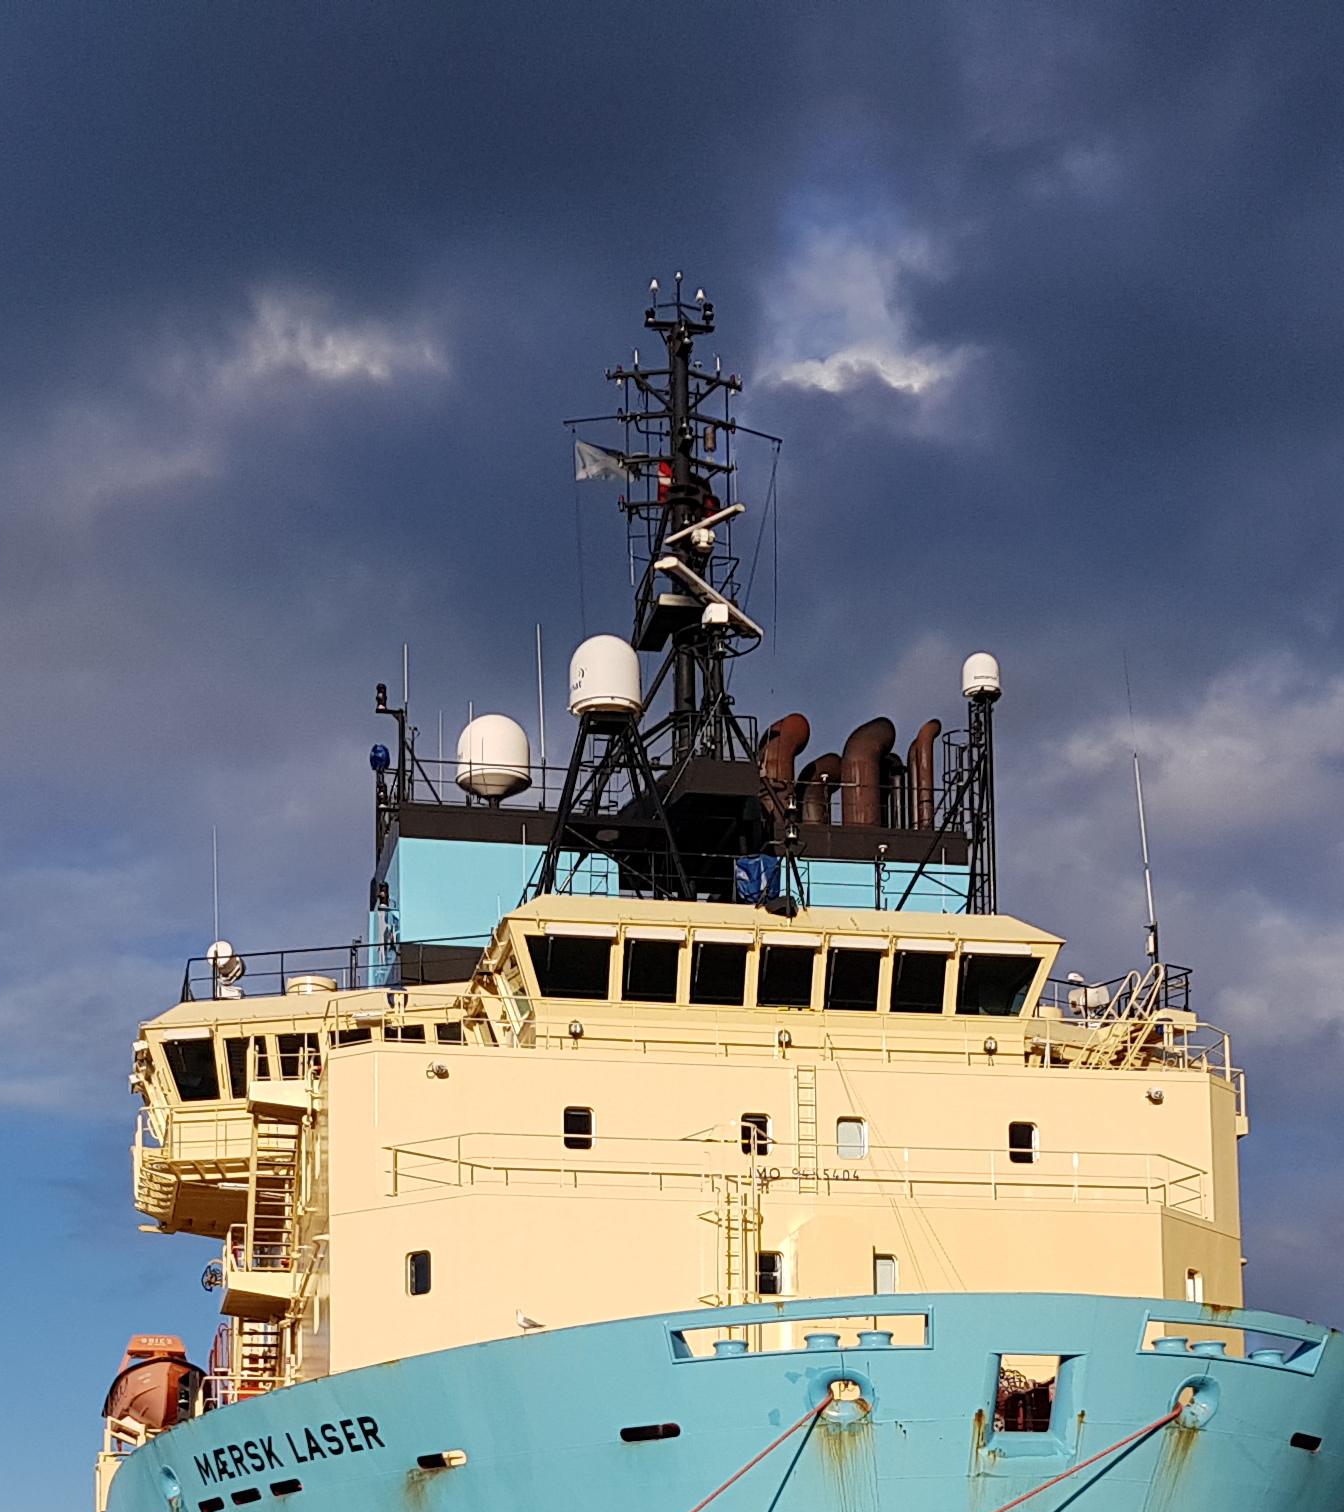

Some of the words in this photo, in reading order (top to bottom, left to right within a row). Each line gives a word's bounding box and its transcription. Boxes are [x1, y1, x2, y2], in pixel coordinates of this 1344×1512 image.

[749, 1166, 781, 1180] IMO
[194, 1436, 284, 1486] MÆRSK
[285, 1416, 386, 1464] LASER
